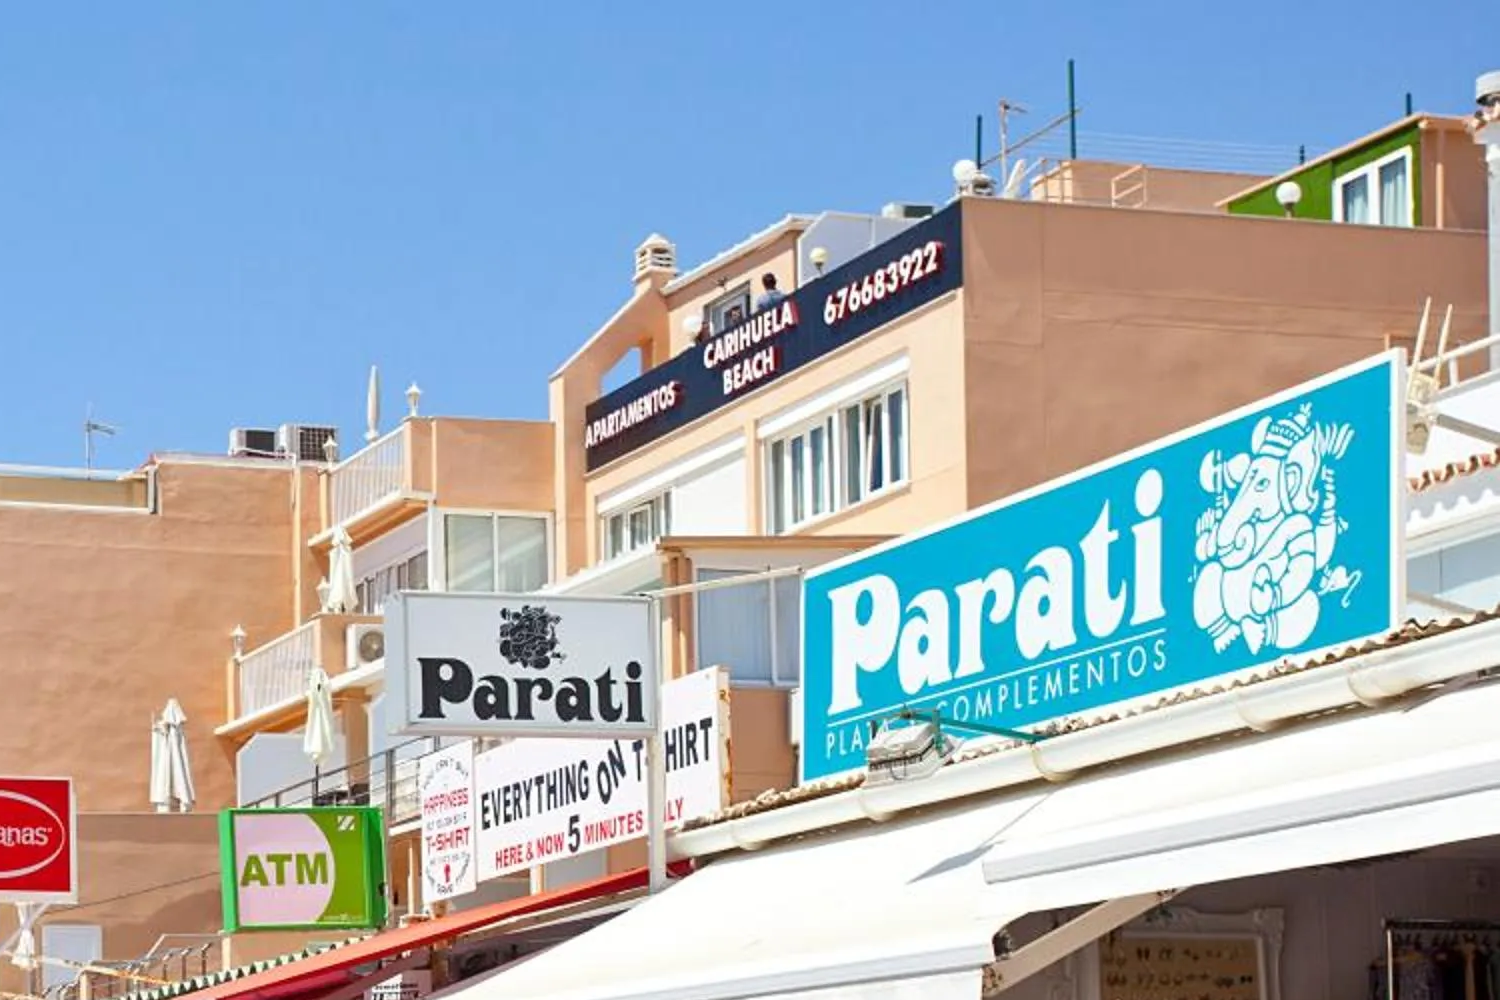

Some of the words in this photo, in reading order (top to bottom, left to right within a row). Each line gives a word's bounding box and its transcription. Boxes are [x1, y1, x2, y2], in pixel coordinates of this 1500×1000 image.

[823, 240, 940, 325] 676683922
[703, 301, 794, 369] CARIHUELA
[723, 346, 775, 395] BEACH
[585, 380, 678, 448] APARTAMENTOS
[827, 468, 1167, 716] Parati
[417, 657, 645, 722] Parati
[481, 760, 589, 830] EVERYTHING
[598, 740, 626, 805] ON
[240, 853, 328, 886] ATM
[425, 826, 470, 856] T-SHIRT
[495, 843, 524, 870] HERE
[525, 842, 535, 861] &
[536, 832, 565, 859] NOW
[567, 816, 581, 852] 5
[583, 810, 644, 842] MINUTES
